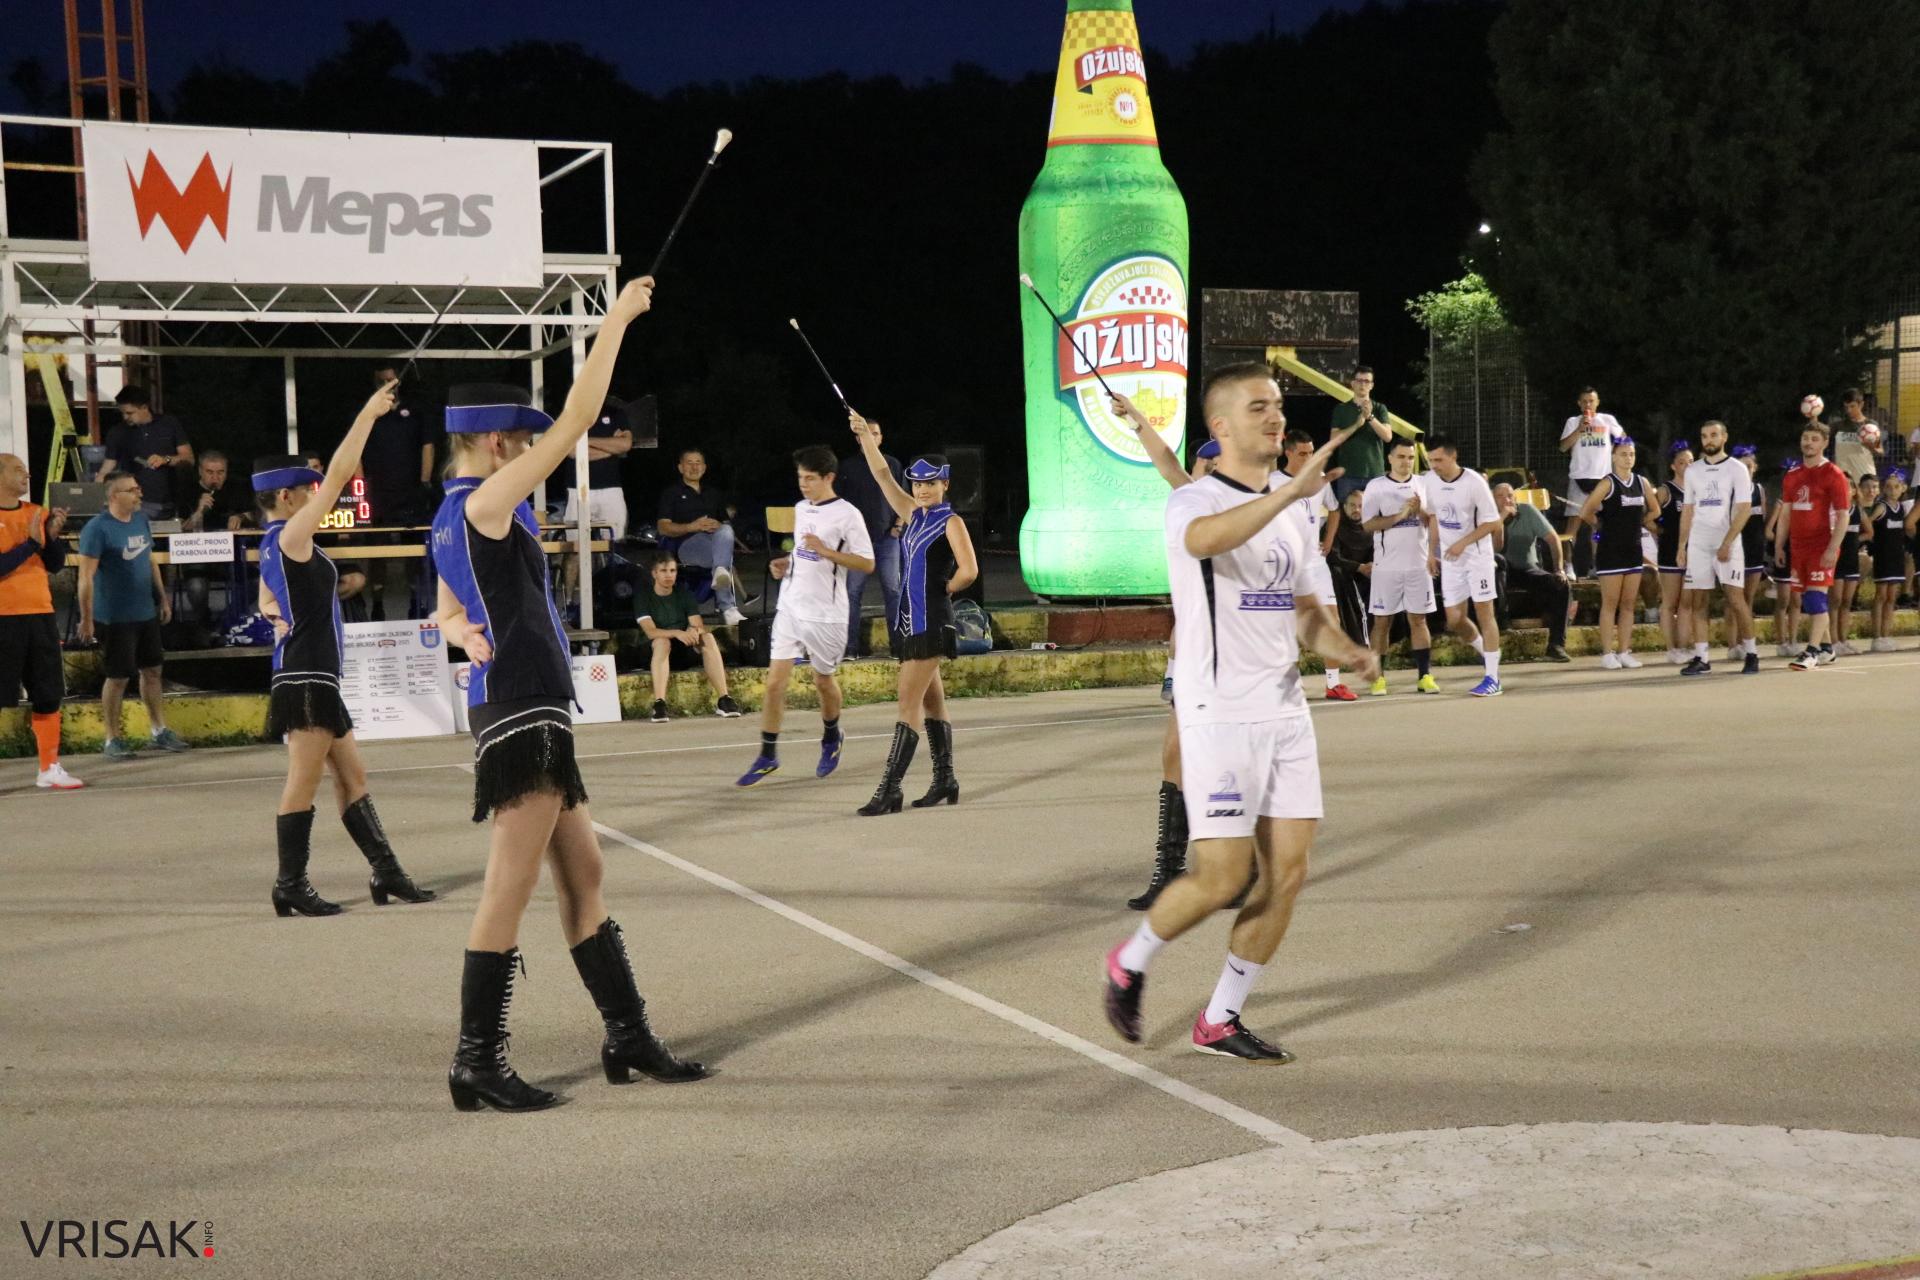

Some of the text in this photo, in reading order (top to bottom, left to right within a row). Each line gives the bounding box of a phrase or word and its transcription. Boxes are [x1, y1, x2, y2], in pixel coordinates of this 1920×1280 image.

[1081, 46, 1147, 81] Ožujsk
[257, 174, 494, 254] Mepas
[1073, 314, 1188, 375] Ožujsk
[353, 479, 365, 496] 0
[359, 502, 370, 519] 0
[127, 535, 147, 549] NIKE
[204, 538, 229, 546] PROVO
[1480, 579, 1488, 590] 8
[1810, 571, 1825, 582] 23
